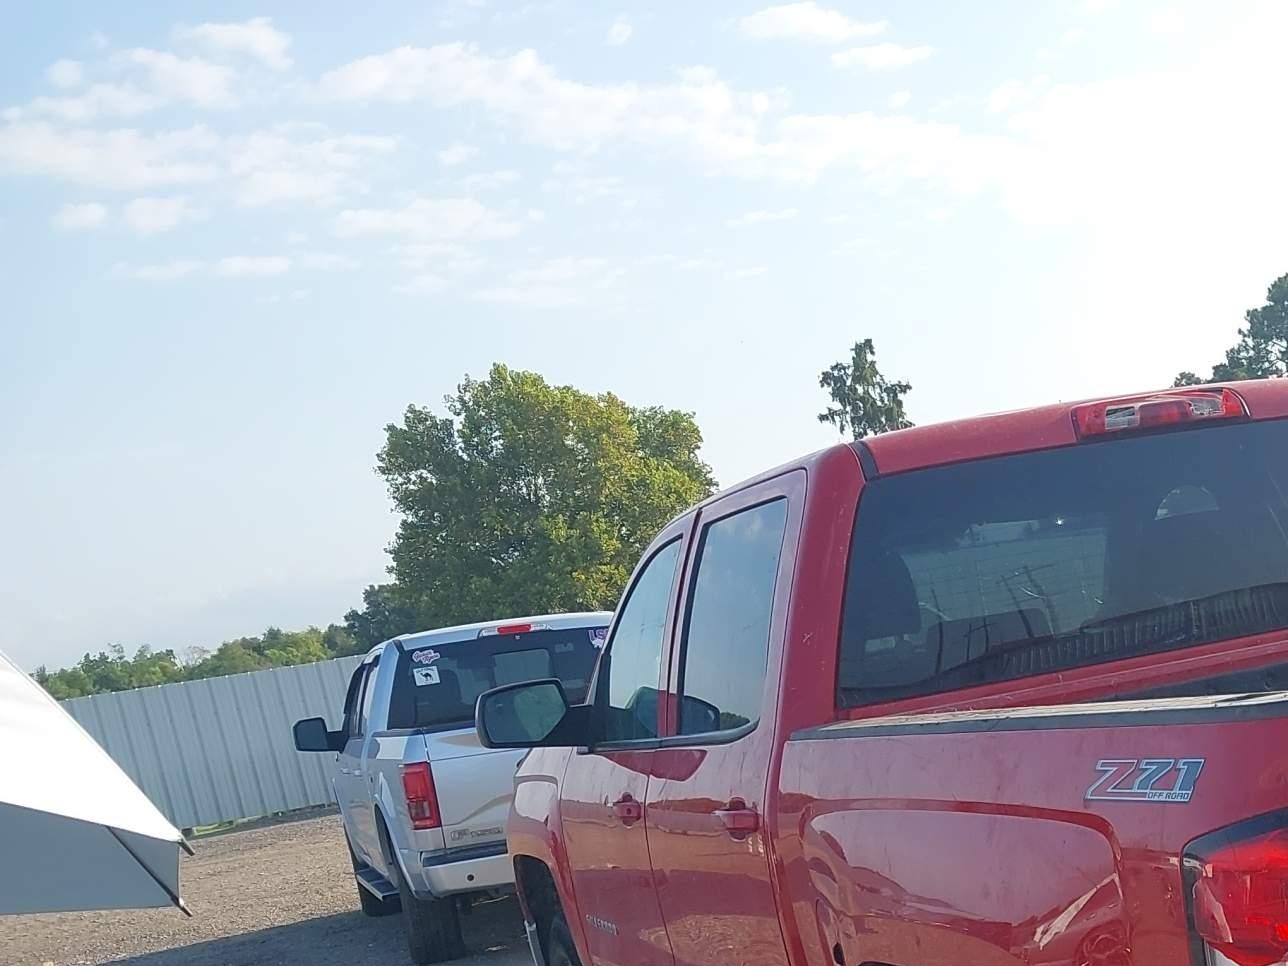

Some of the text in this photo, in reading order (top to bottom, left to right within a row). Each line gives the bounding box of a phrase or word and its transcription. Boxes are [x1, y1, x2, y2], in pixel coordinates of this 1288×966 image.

[1086, 759, 1205, 799] Z71
[1147, 791, 1190, 800] OFF ROAD
